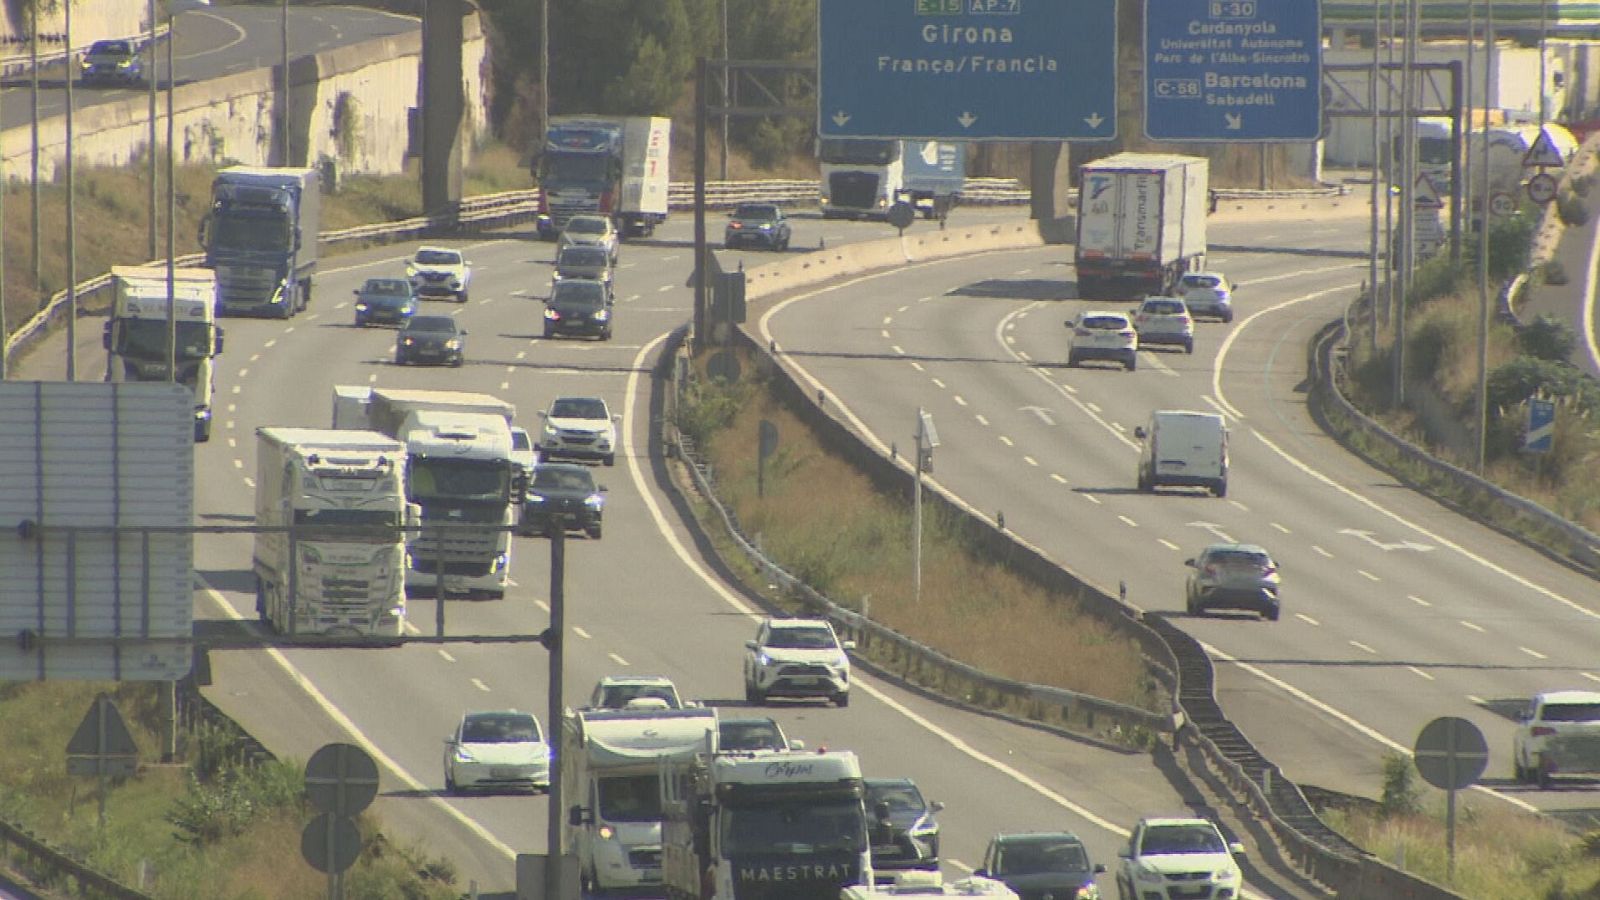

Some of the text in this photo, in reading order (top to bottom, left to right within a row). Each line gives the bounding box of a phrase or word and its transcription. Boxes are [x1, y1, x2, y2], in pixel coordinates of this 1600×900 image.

[972, 0, 1015, 11] AP-7
[1212, 2, 1252, 16] B-30
[922, 24, 1013, 43] Girona
[1189, 20, 1276, 36] Cerdanyola
[1161, 38, 1232, 49] Universitat
[878, 55, 1057, 73] França/Francia
[1155, 52, 1182, 63] Parc
[1189, 52, 1203, 63] de
[1205, 72, 1306, 88] Barcelona
[1158, 82, 1198, 95] C-58
[1206, 93, 1275, 105] Sabadell
[740, 863, 850, 881] MAESTRAT
